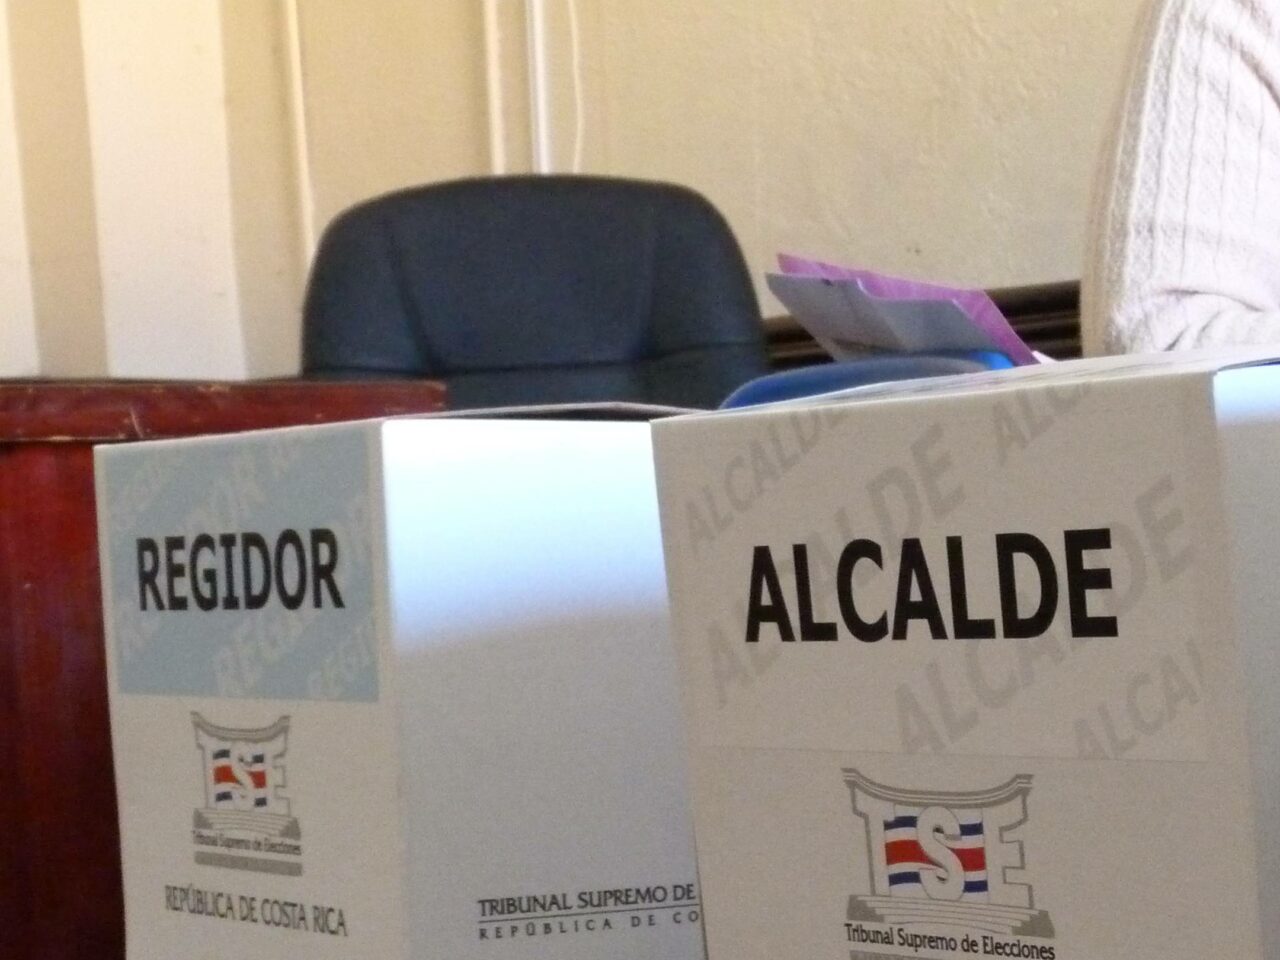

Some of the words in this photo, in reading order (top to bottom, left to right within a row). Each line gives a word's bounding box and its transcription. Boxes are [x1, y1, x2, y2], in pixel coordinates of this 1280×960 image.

[135, 528, 345, 612] REGIDOR
[745, 528, 1119, 643] ALCALDE
[165, 883, 235, 921] REPÚBLICA
[239, 895, 257, 923] DE
[261, 898, 308, 931] COSTA
[313, 906, 348, 937] RICA
[478, 893, 572, 917] TRIBUNAL
[577, 886, 667, 909] SUPREMO
[673, 884, 696, 900] DE
[631, 915, 656, 928] DE
[844, 923, 894, 945] Tribunal
[897, 928, 957, 953] Supremo
[961, 933, 979, 953] de
[981, 935, 1055, 960] Elecciones
